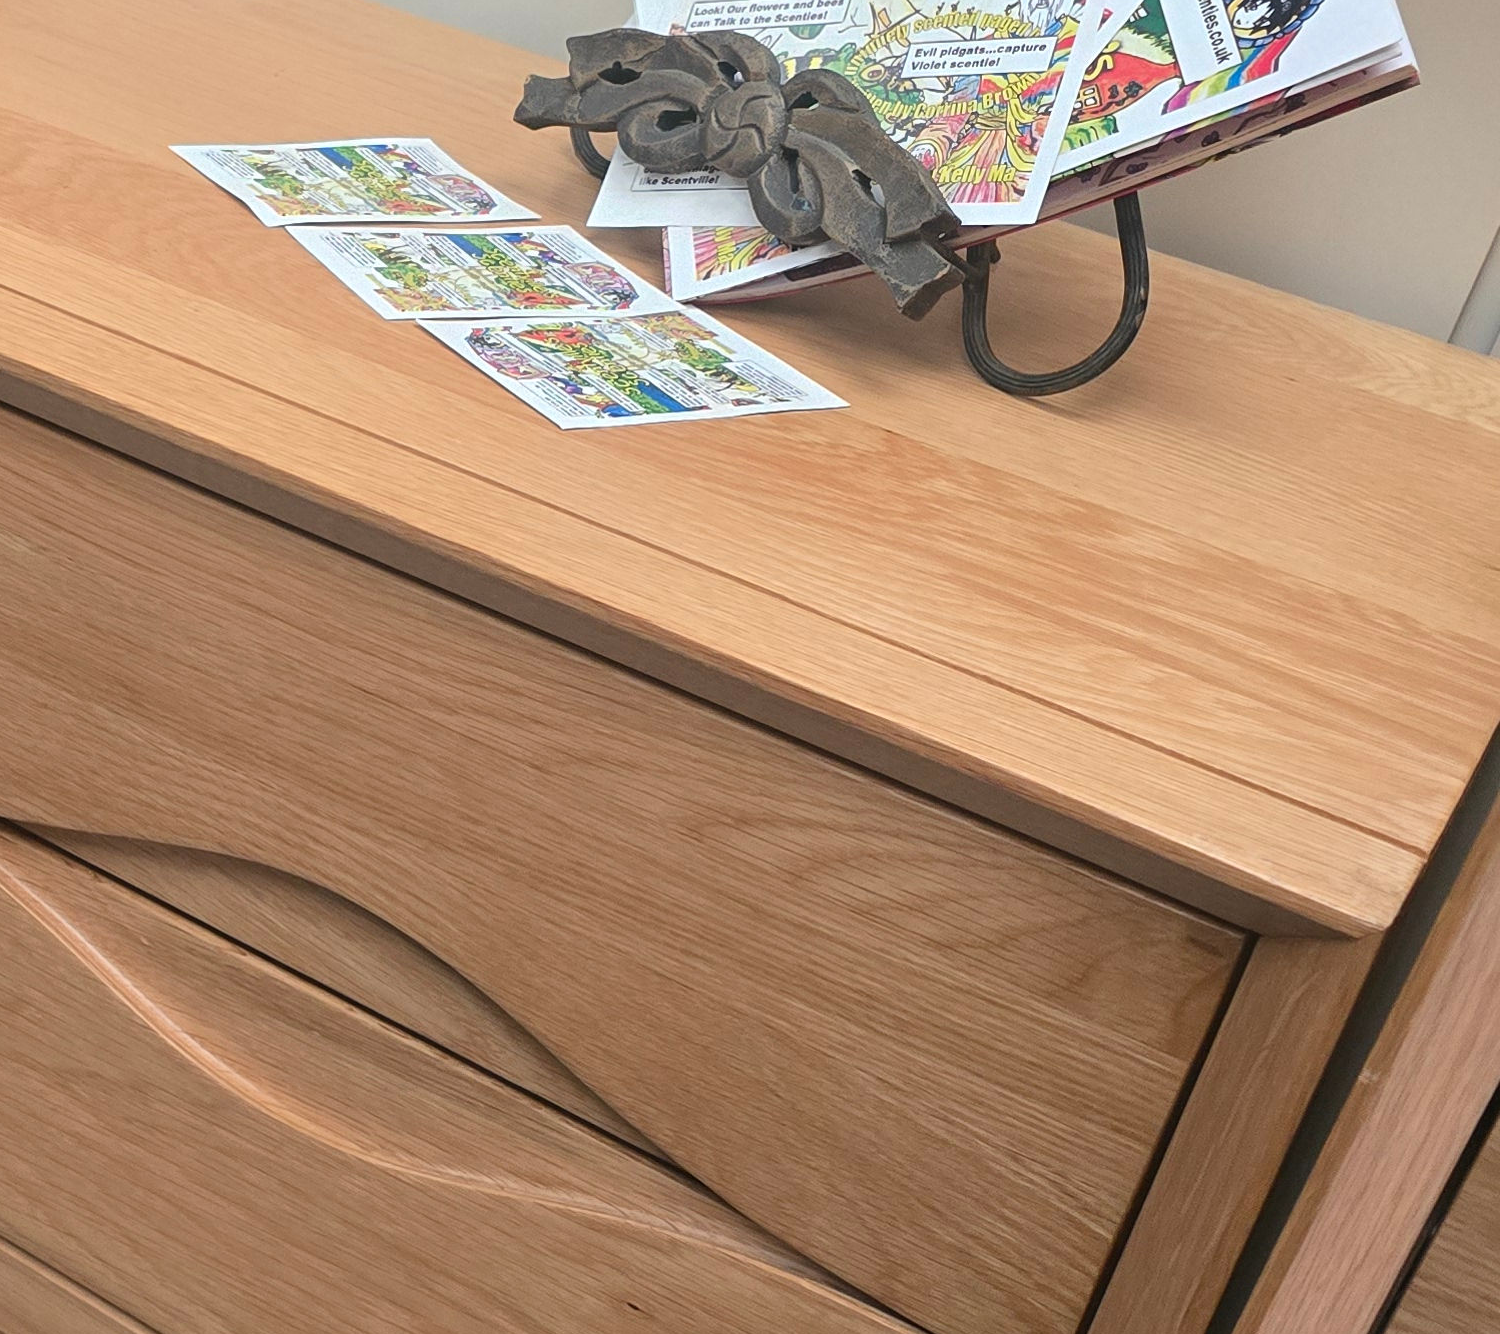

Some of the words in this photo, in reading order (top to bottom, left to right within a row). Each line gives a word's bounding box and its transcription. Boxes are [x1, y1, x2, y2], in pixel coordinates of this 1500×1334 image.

[694, 5, 724, 16] Look!
[727, 4, 747, 14] Our
[749, 0, 790, 12] flowers
[792, 0, 813, 9] and
[690, 19, 710, 28] can
[713, 16, 736, 27] Talk
[739, 15, 751, 25] to
[753, 14, 772, 24] the
[774, 10, 829, 22] Scenties!
[914, 48, 937, 58] Evil
[911, 60, 947, 71] Violet
[950, 57, 1001, 69] scentie!
[987, 164, 1016, 182] Ma
